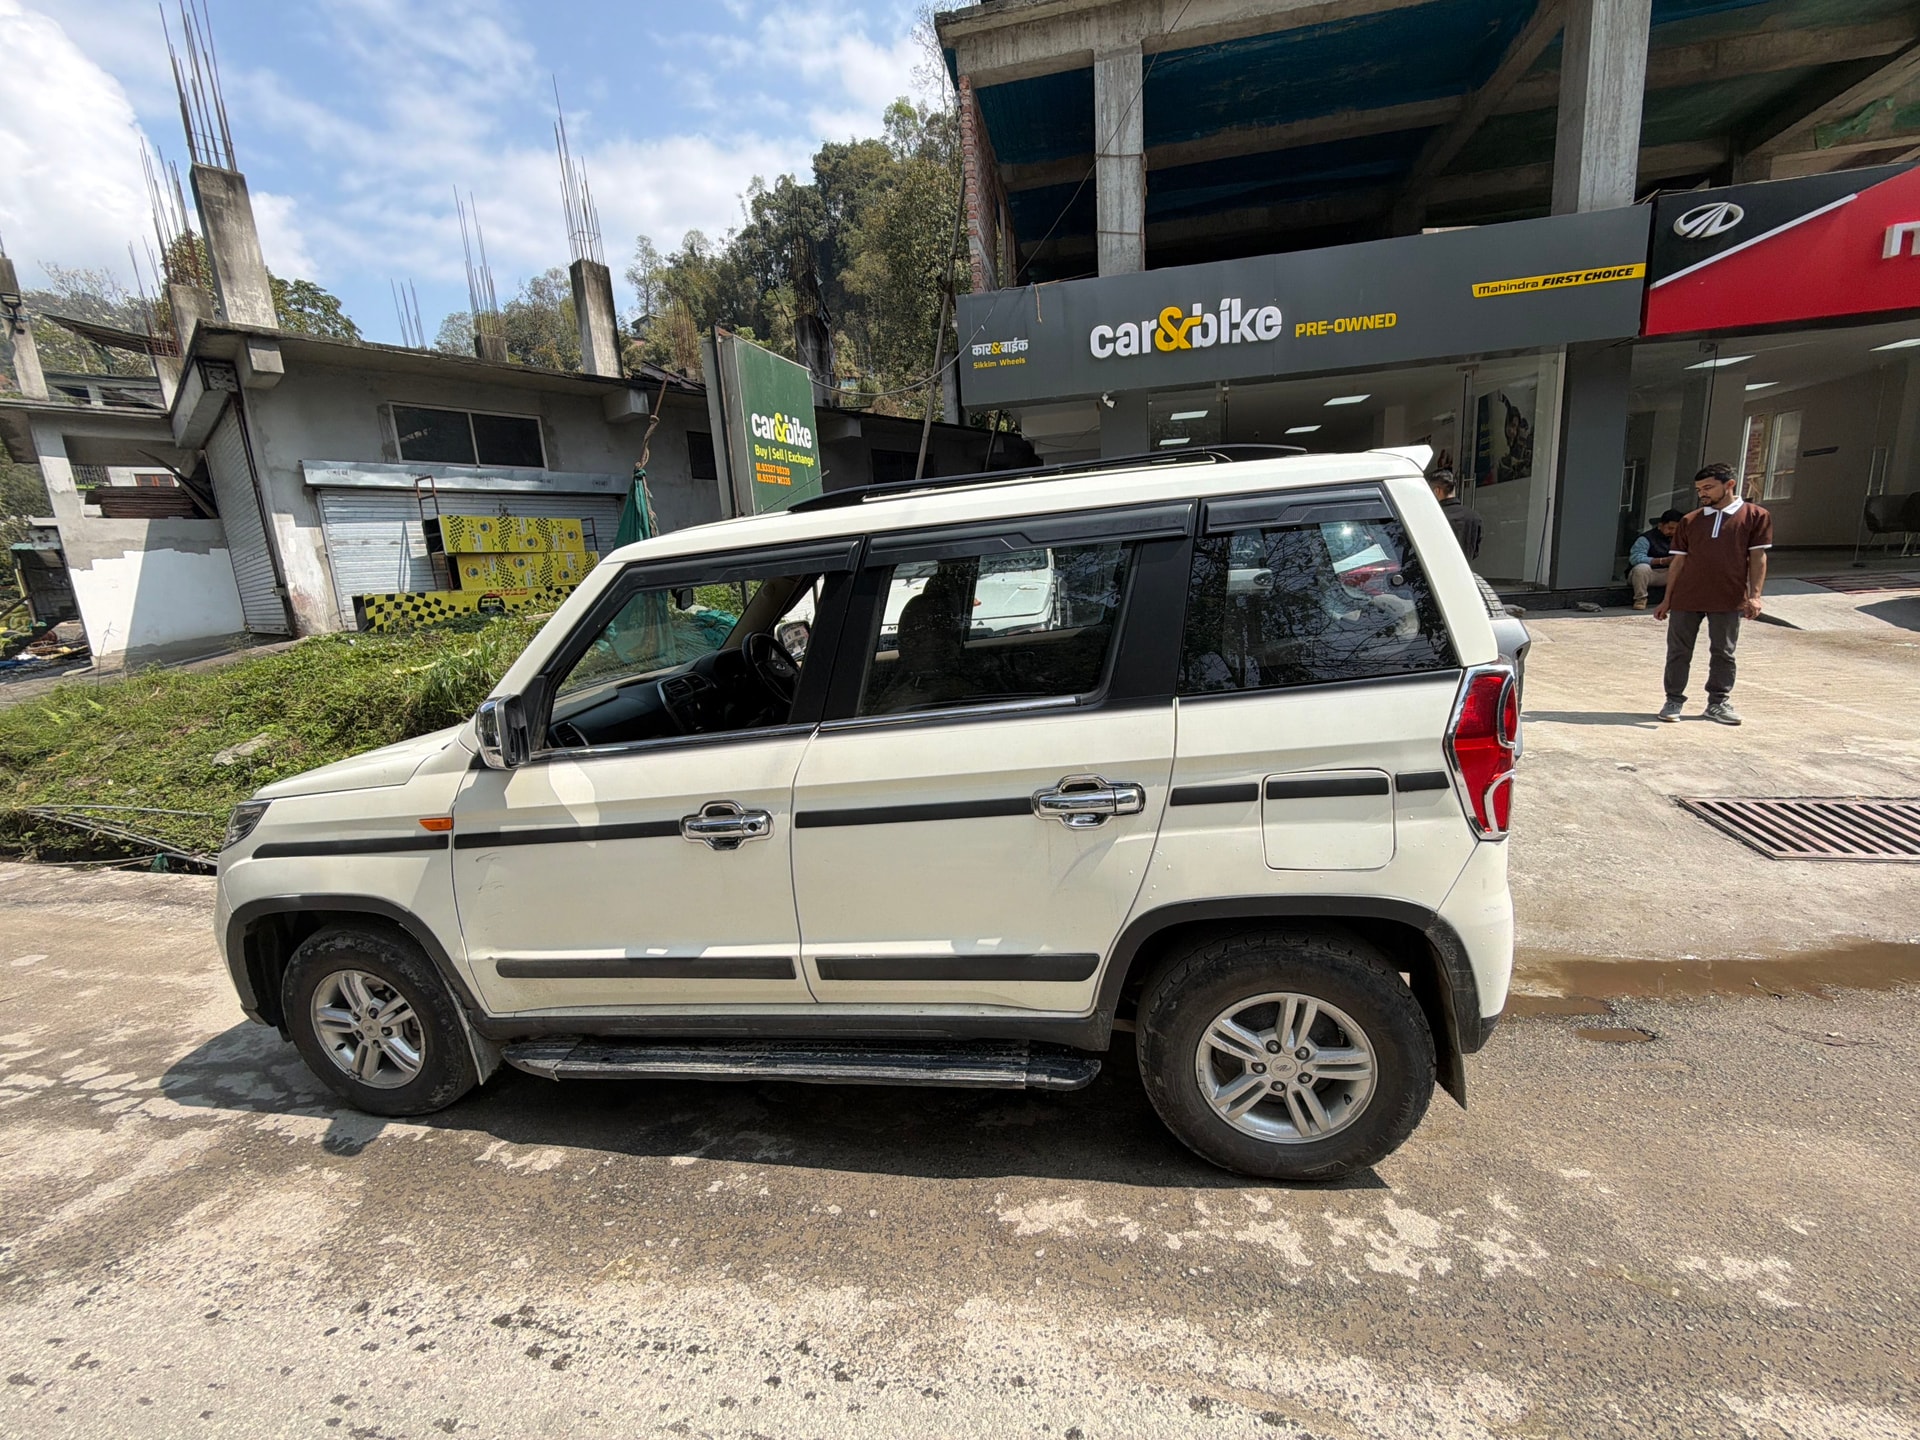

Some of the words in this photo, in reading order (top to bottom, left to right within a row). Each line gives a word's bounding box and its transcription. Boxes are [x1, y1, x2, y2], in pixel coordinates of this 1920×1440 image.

[1478, 281, 1538, 295] Mahindra
[1541, 274, 1582, 287] FIRST
[1583, 267, 1634, 281] CHOICE
[1089, 298, 1282, 358] car&bike
[1295, 312, 1397, 338] PRE-OWNED
[973, 361, 997, 369] Sikkim
[999, 357, 1026, 366] Wheels
[751, 412, 812, 448] car&bike
[754, 444, 768, 460] Buy
